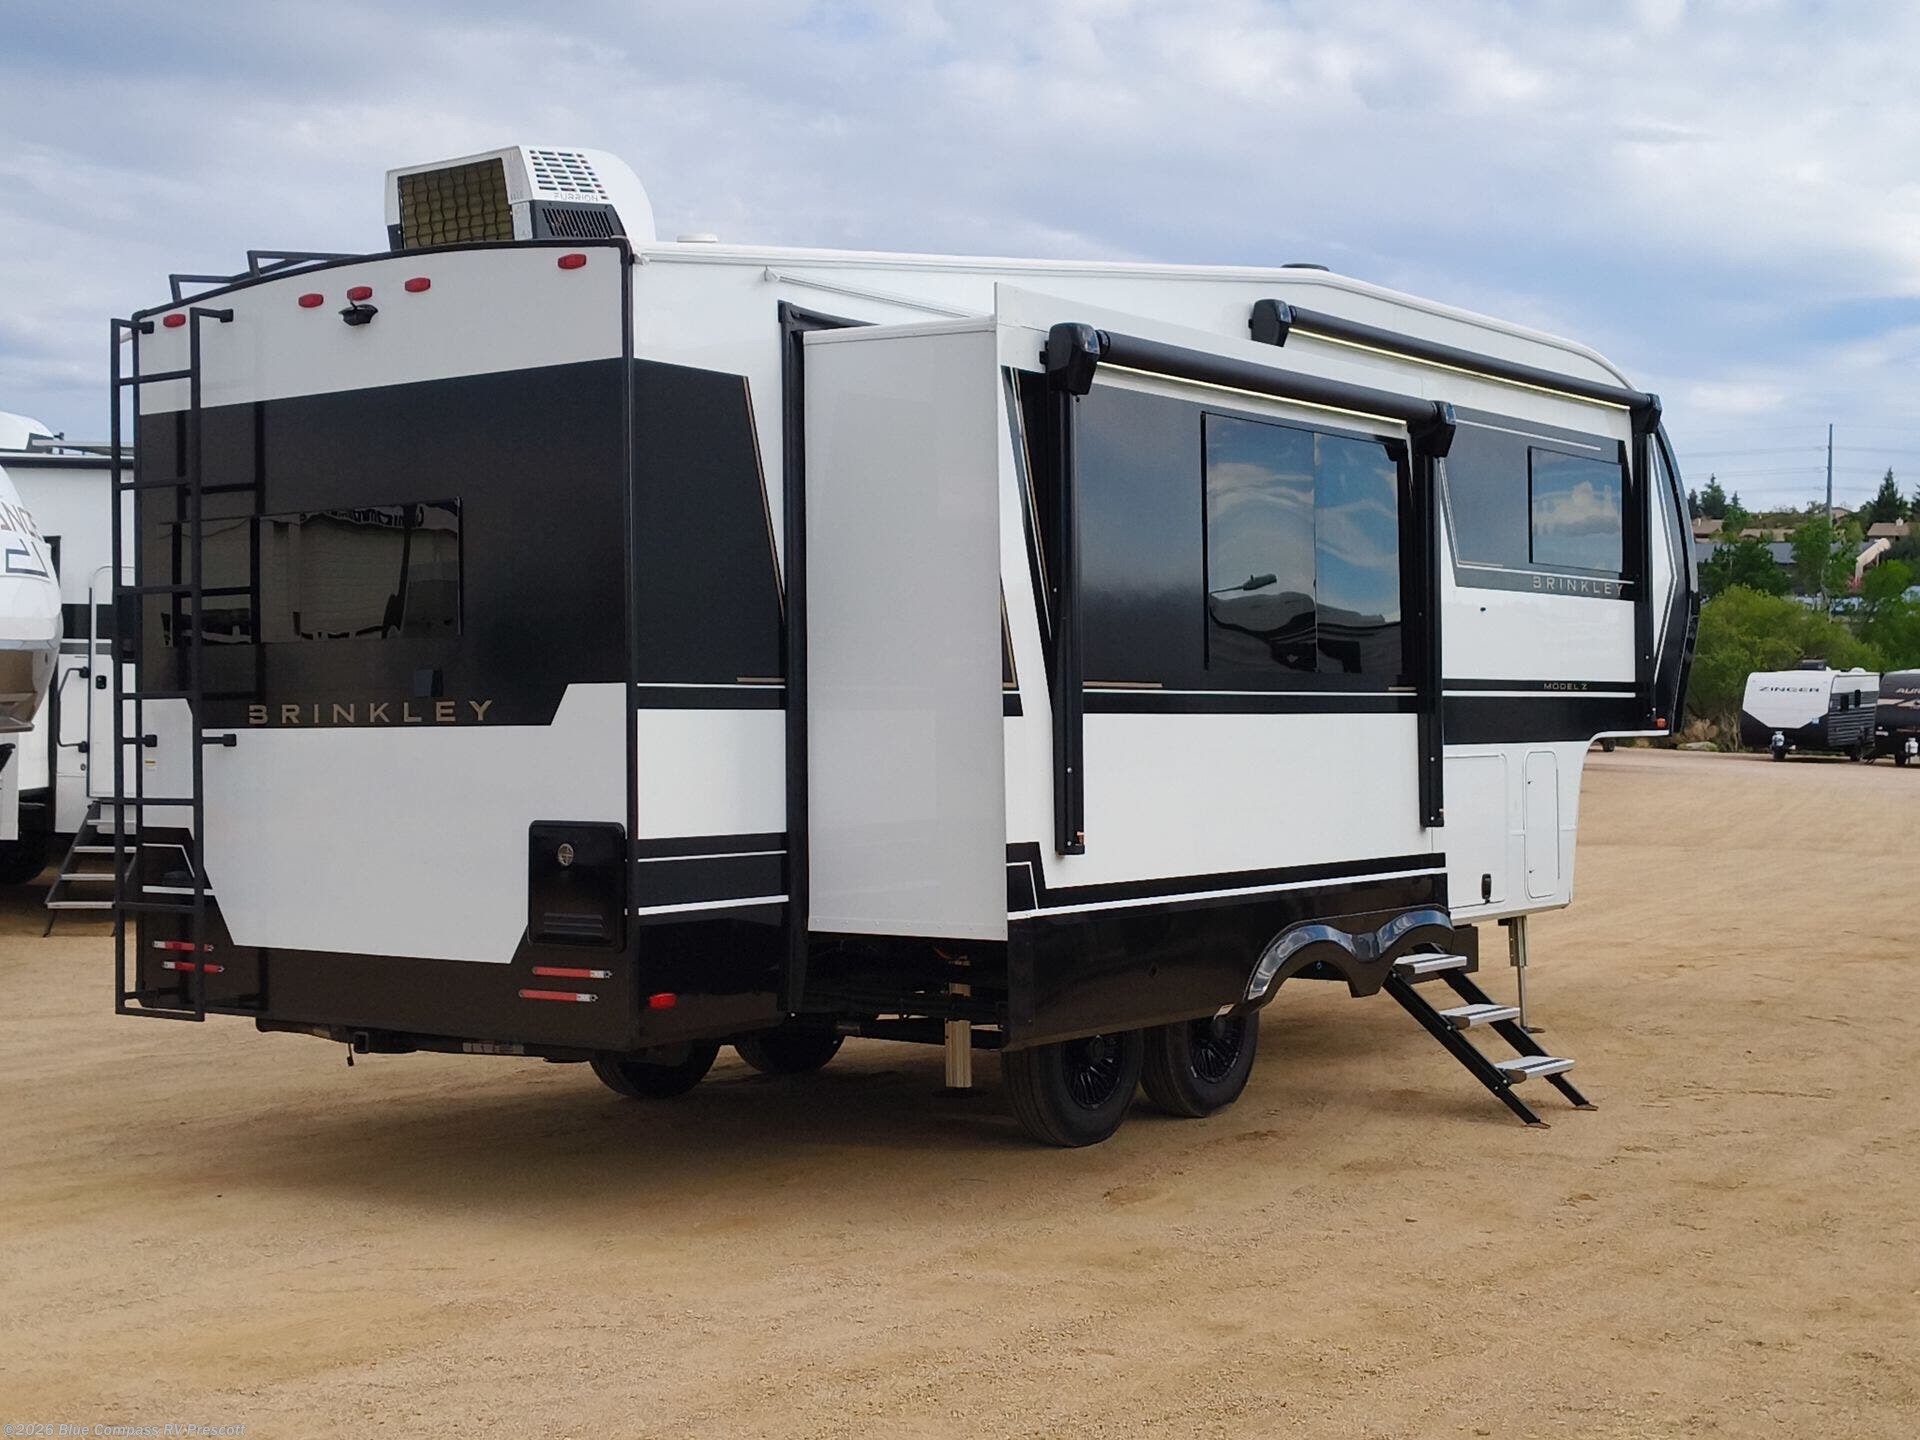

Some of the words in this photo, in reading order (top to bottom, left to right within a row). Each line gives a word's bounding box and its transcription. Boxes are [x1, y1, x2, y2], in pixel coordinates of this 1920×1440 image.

[1532, 575, 1624, 596] BRINKLEY
[1543, 682, 1579, 690] MODEL
[248, 699, 493, 724] BRINKLEY
